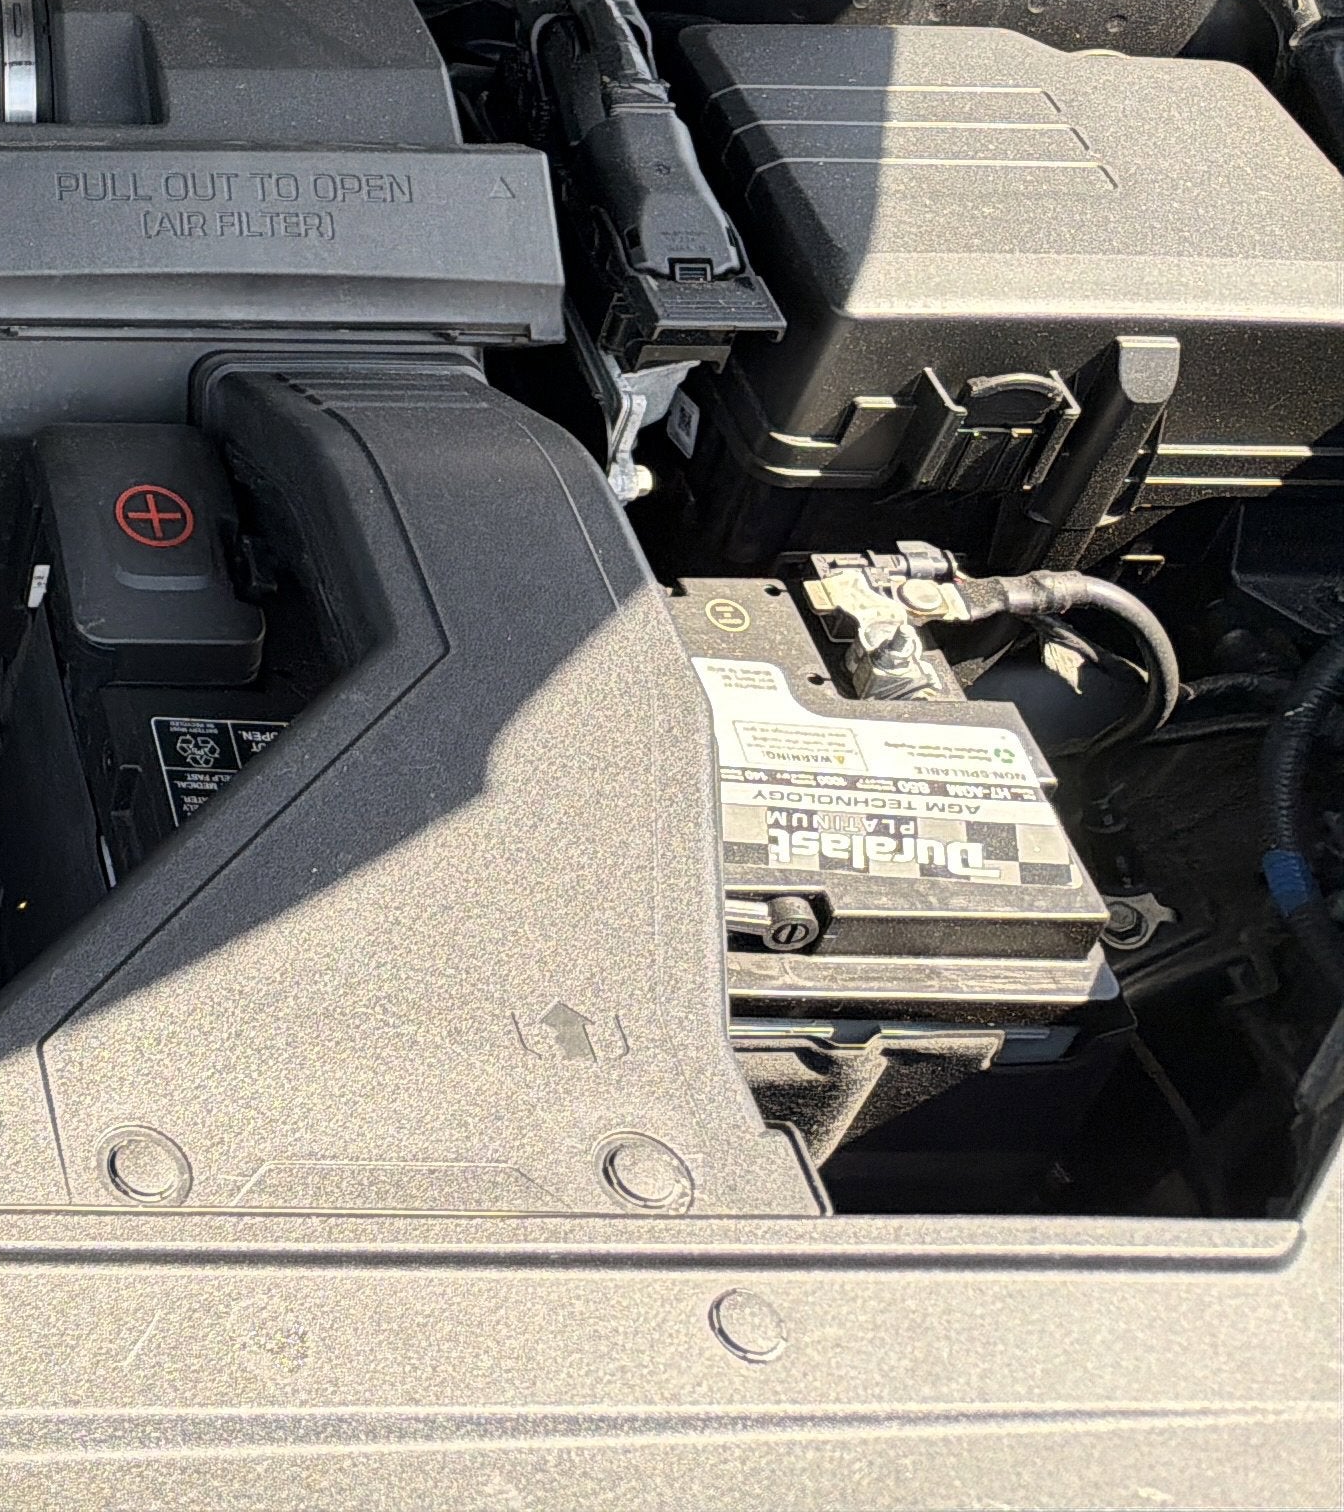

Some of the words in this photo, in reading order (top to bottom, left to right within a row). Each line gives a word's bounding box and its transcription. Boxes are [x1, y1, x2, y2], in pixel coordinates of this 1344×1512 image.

[55, 171, 153, 202] PULL
[163, 171, 239, 202] OUT
[247, 172, 301, 203] TO
[312, 173, 413, 204] OPEN
[751, 789, 916, 811] TECHNOLOGY
[925, 801, 981, 814] AGM
[765, 809, 916, 836] PLATINUM
[767, 828, 1001, 879] Duralast
